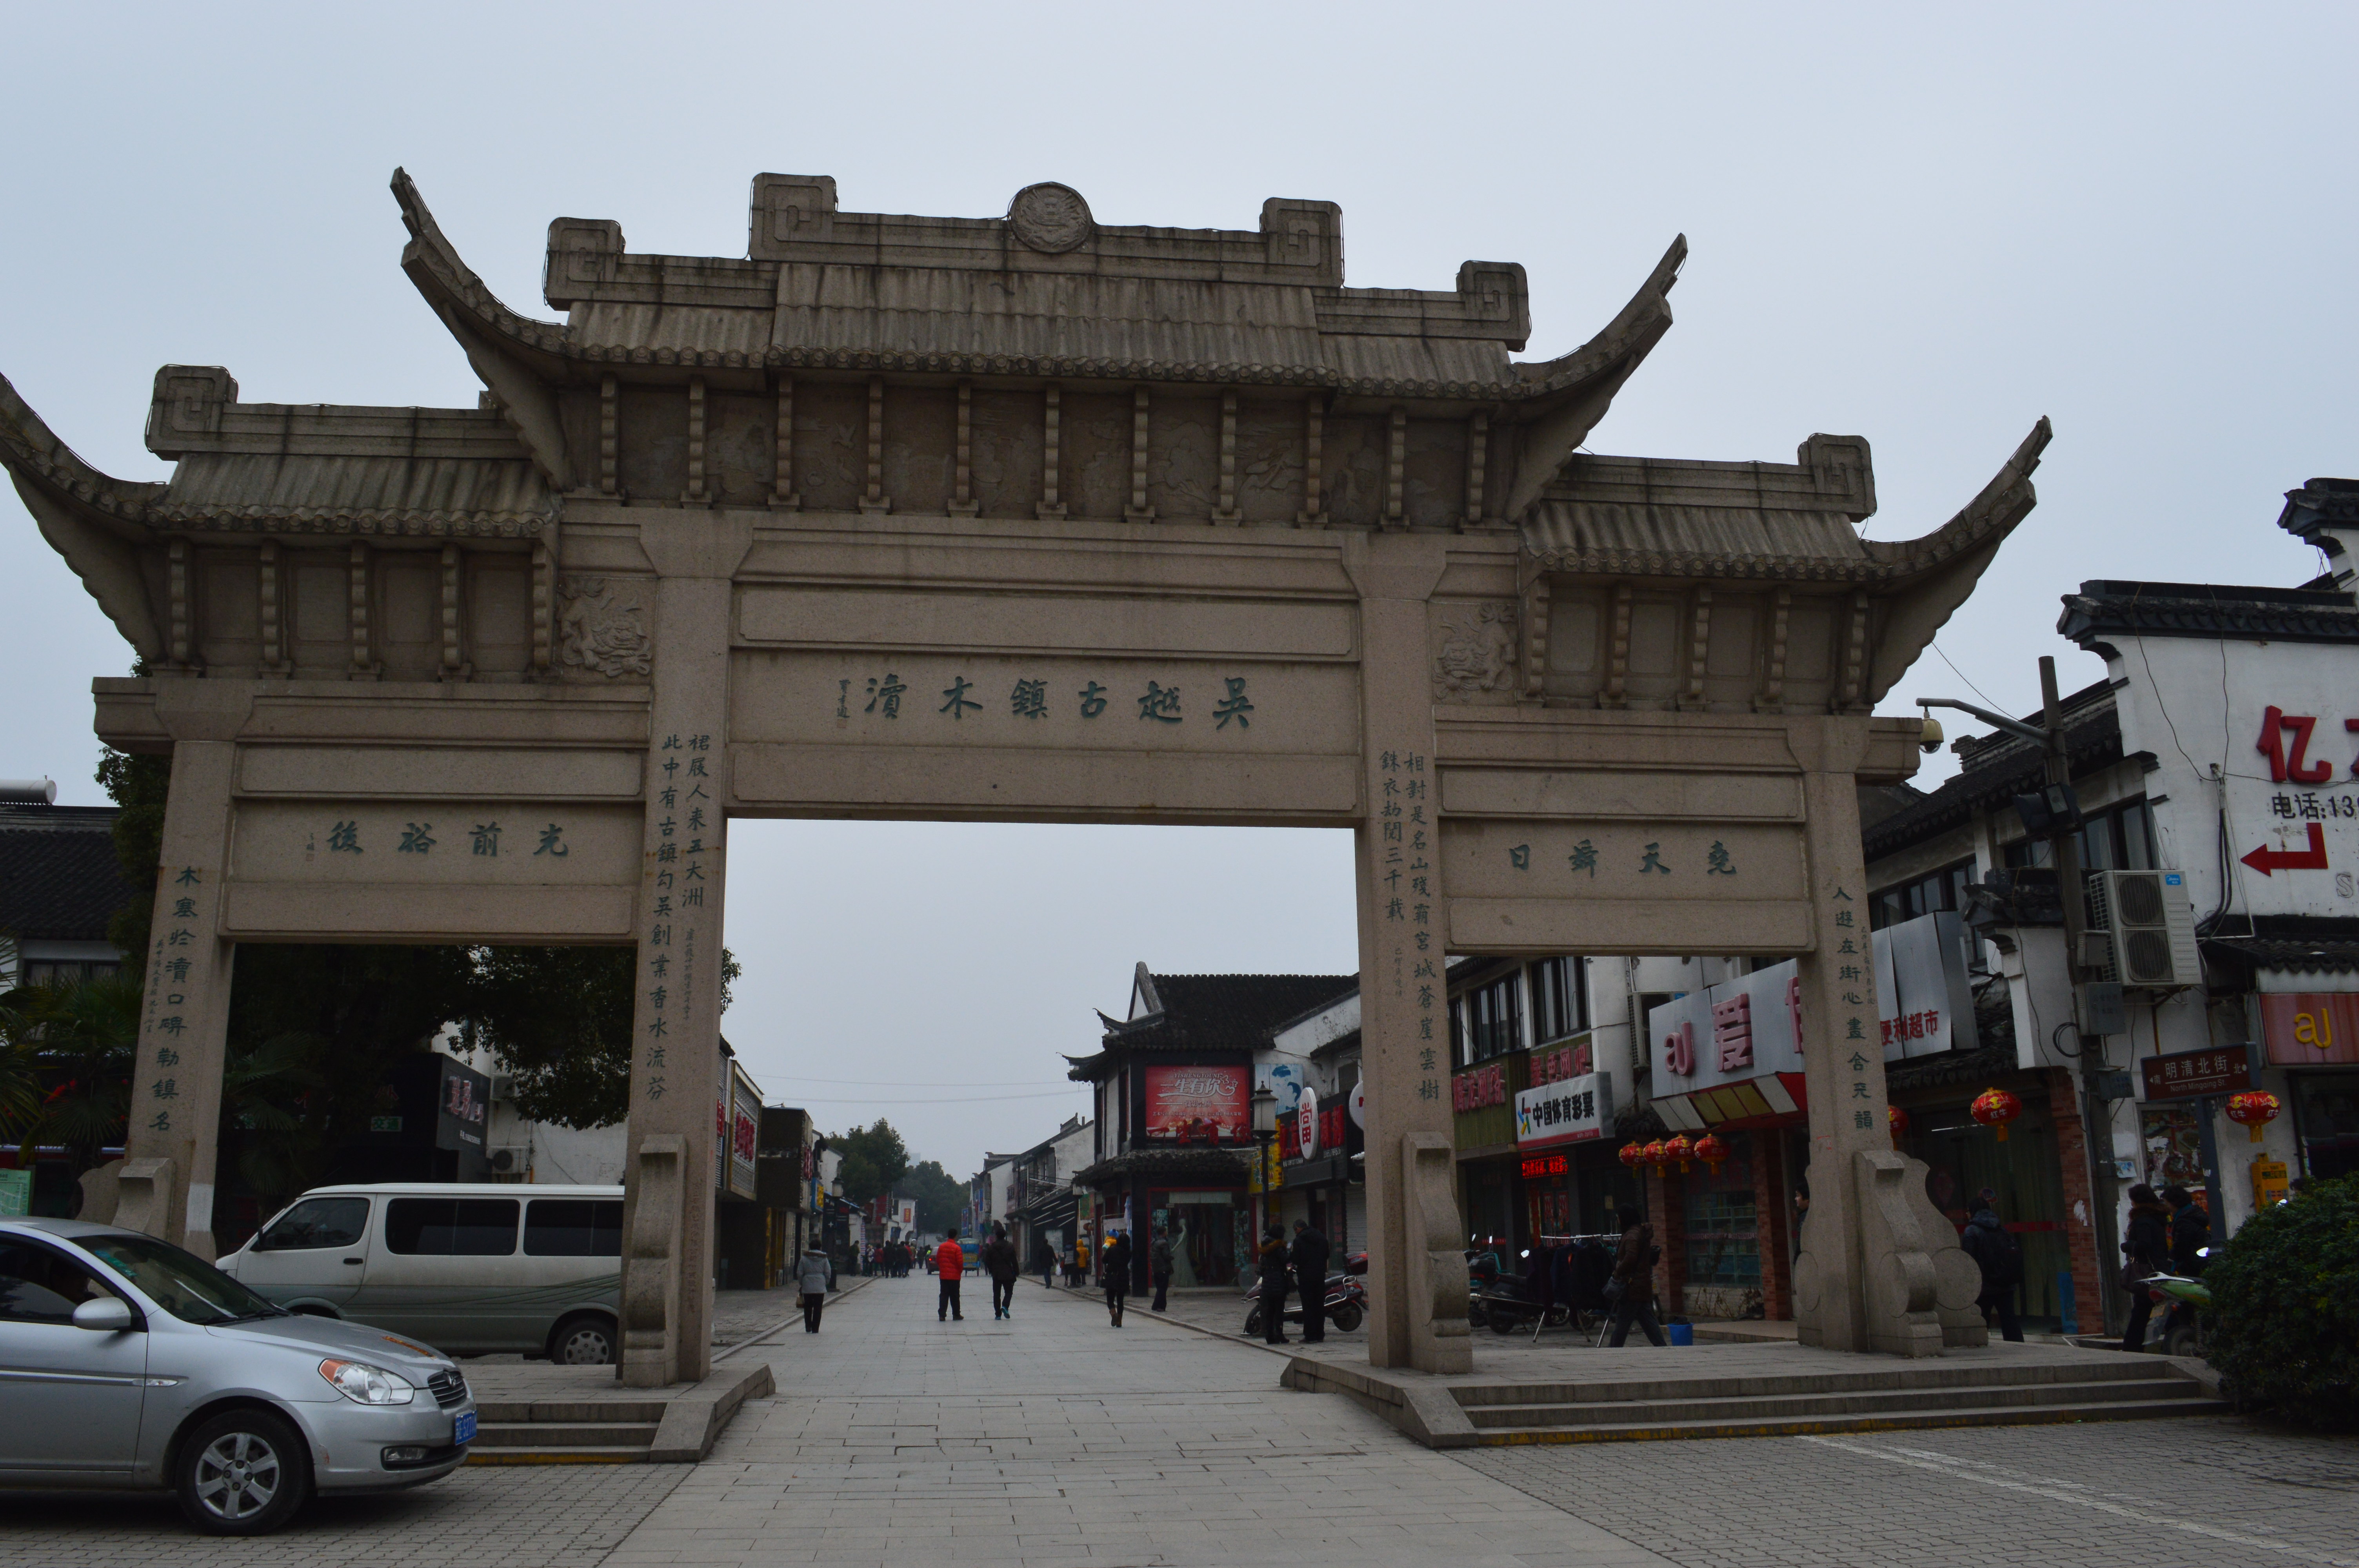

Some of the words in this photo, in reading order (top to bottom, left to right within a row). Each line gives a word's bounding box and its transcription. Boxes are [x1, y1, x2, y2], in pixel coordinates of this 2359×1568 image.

[2256, 705, 2359, 783] 亿
[2272, 792, 2359, 820] 电话:13
[1880, 1009, 1938, 1046] 便利超市
[2154, 1074, 2161, 1085] 南
[2165, 1055, 2227, 1078] 明清北街
[2233, 1063, 2242, 1074] 北
[1160, 1078, 1223, 1096] 一生有你
[2170, 1083, 2187, 1092] North
[2217, 1078, 2227, 1087] St.
[1532, 1090, 1595, 1127] 中国体育彩票
[1990, 1108, 2008, 1119] 红牛
[2230, 1109, 2246, 1119] 红牛
